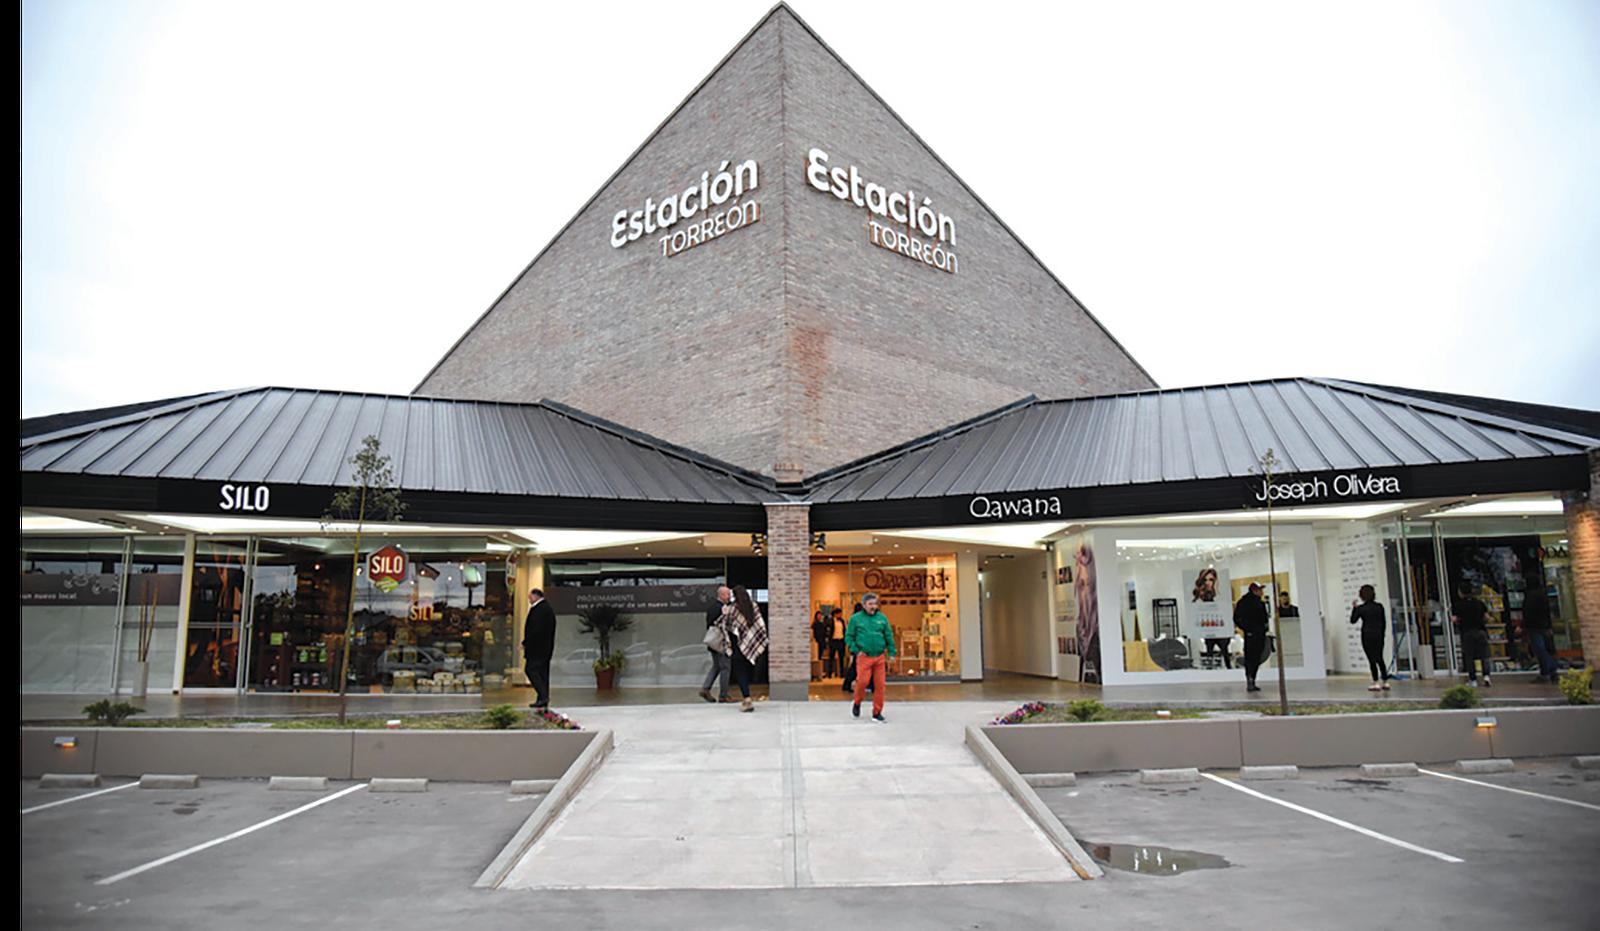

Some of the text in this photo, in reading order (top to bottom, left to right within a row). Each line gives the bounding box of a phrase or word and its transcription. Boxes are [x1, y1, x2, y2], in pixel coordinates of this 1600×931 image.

[610, 159, 759, 248] Estación
[807, 148, 956, 247] Estación
[219, 484, 270, 511] SILO
[1256, 473, 1401, 502] Joseph Olivera
[969, 495, 1062, 518] Qawana
[371, 555, 404, 574] SILO
